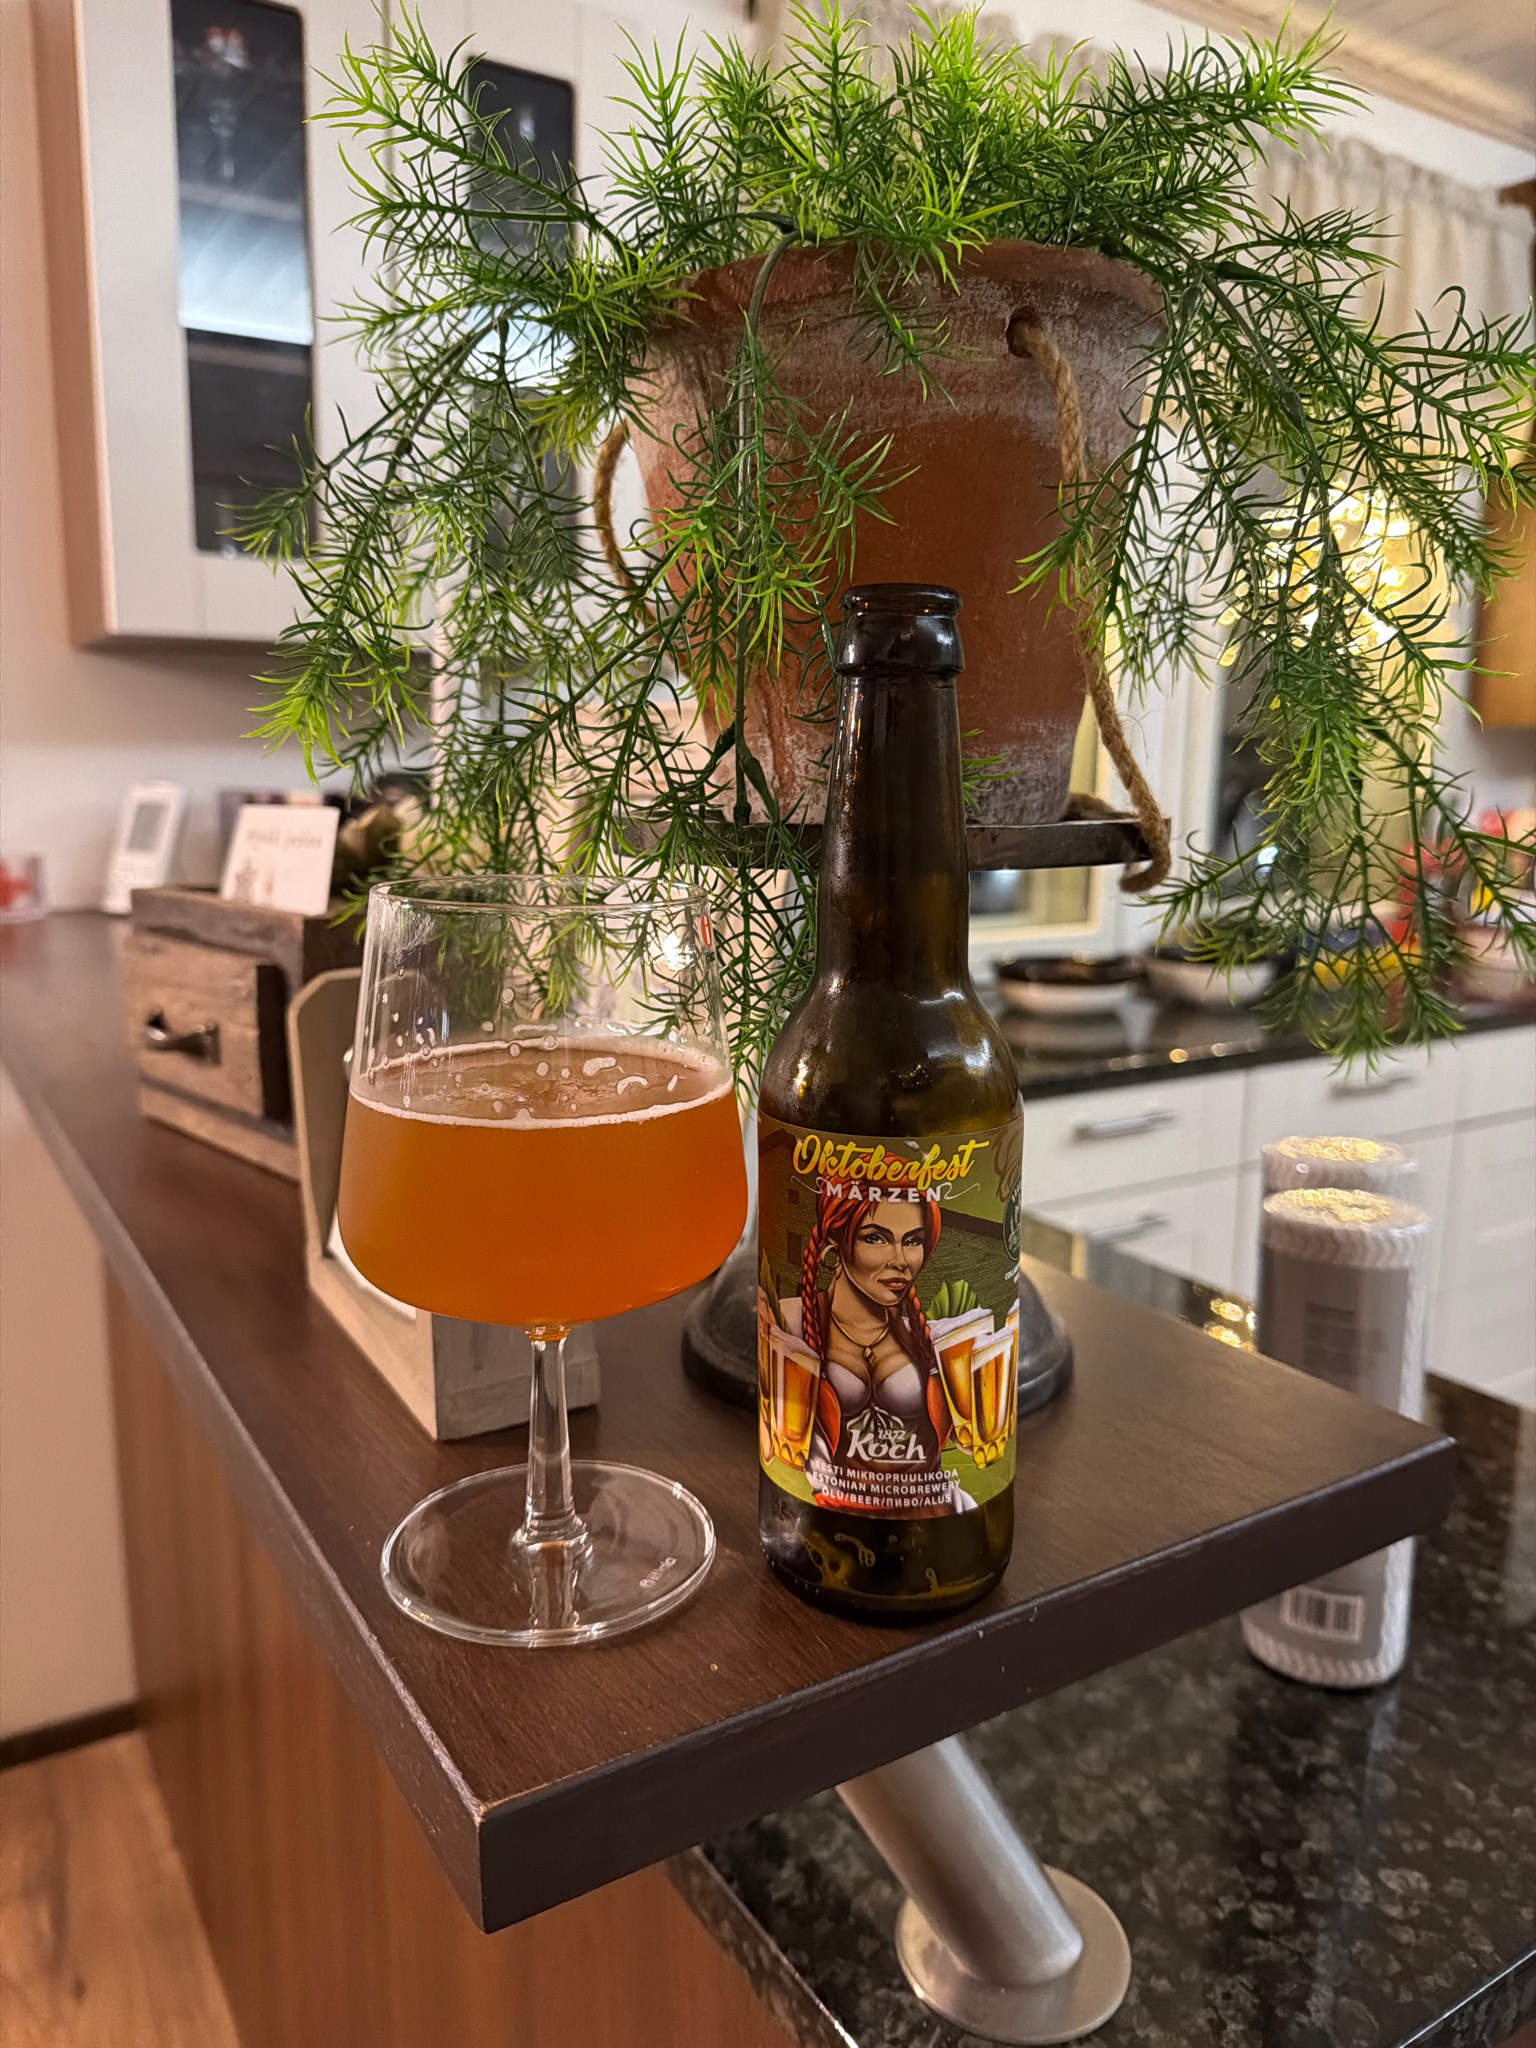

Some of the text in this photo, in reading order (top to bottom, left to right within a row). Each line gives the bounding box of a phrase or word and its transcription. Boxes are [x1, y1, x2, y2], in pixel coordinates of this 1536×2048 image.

[792, 1134, 990, 1190] Oktoberfest
[826, 1181, 942, 1203] MÄRZEN
[846, 1429, 928, 1462] Koch
[812, 1471, 961, 1495] ESTONIAN MICROBREWERY
[814, 1462, 959, 1483] EESTI MIKROPRUULIKODA
